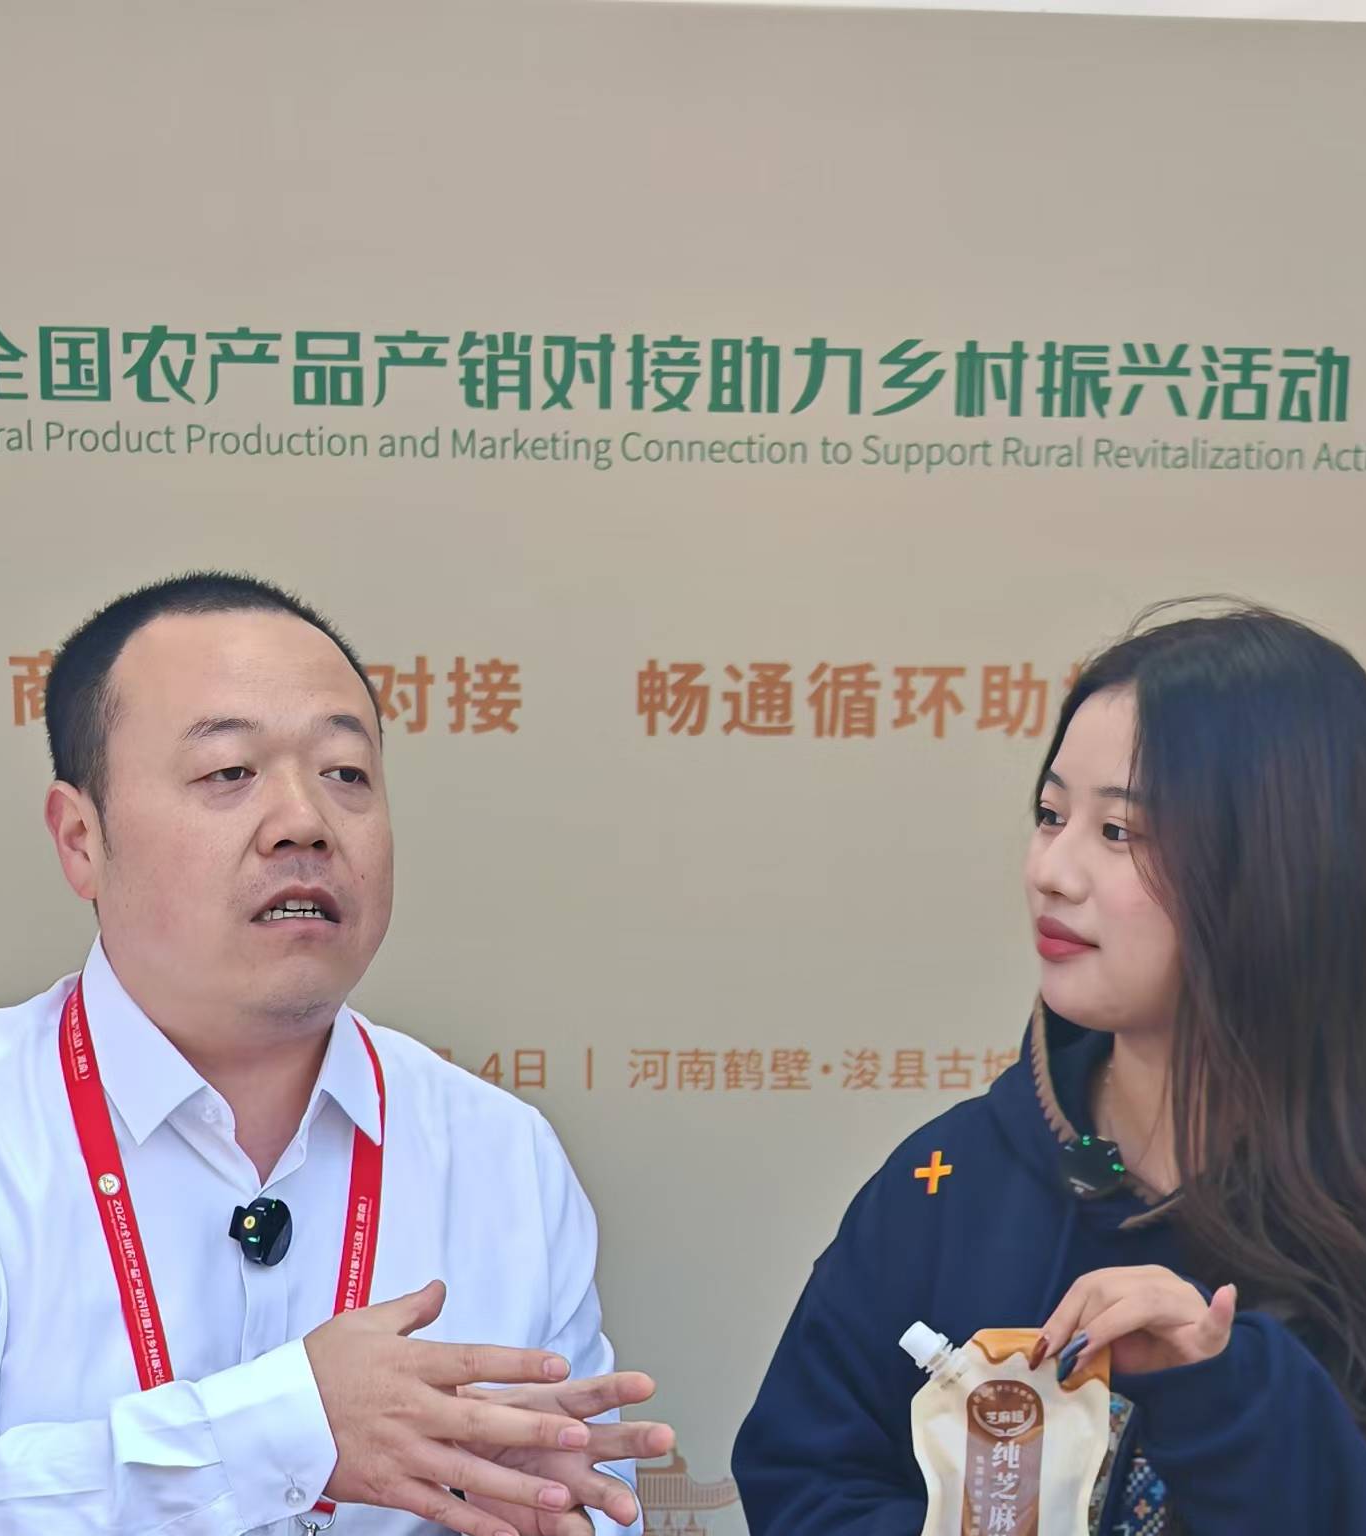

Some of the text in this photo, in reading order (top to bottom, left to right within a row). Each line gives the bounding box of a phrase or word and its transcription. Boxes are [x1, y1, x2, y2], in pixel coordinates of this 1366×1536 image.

[45, 420, 175, 456] Product
[187, 423, 367, 459] Production
[380, 428, 439, 459] and
[452, 429, 612, 471] Marketing
[620, 431, 808, 465] Connection
[821, 438, 851, 466] to
[862, 436, 992, 473] Support
[1002, 437, 1083, 468] Rural
[1094, 439, 1304, 472] Revitalization
[636, 659, 1081, 738] 畅通循环助
